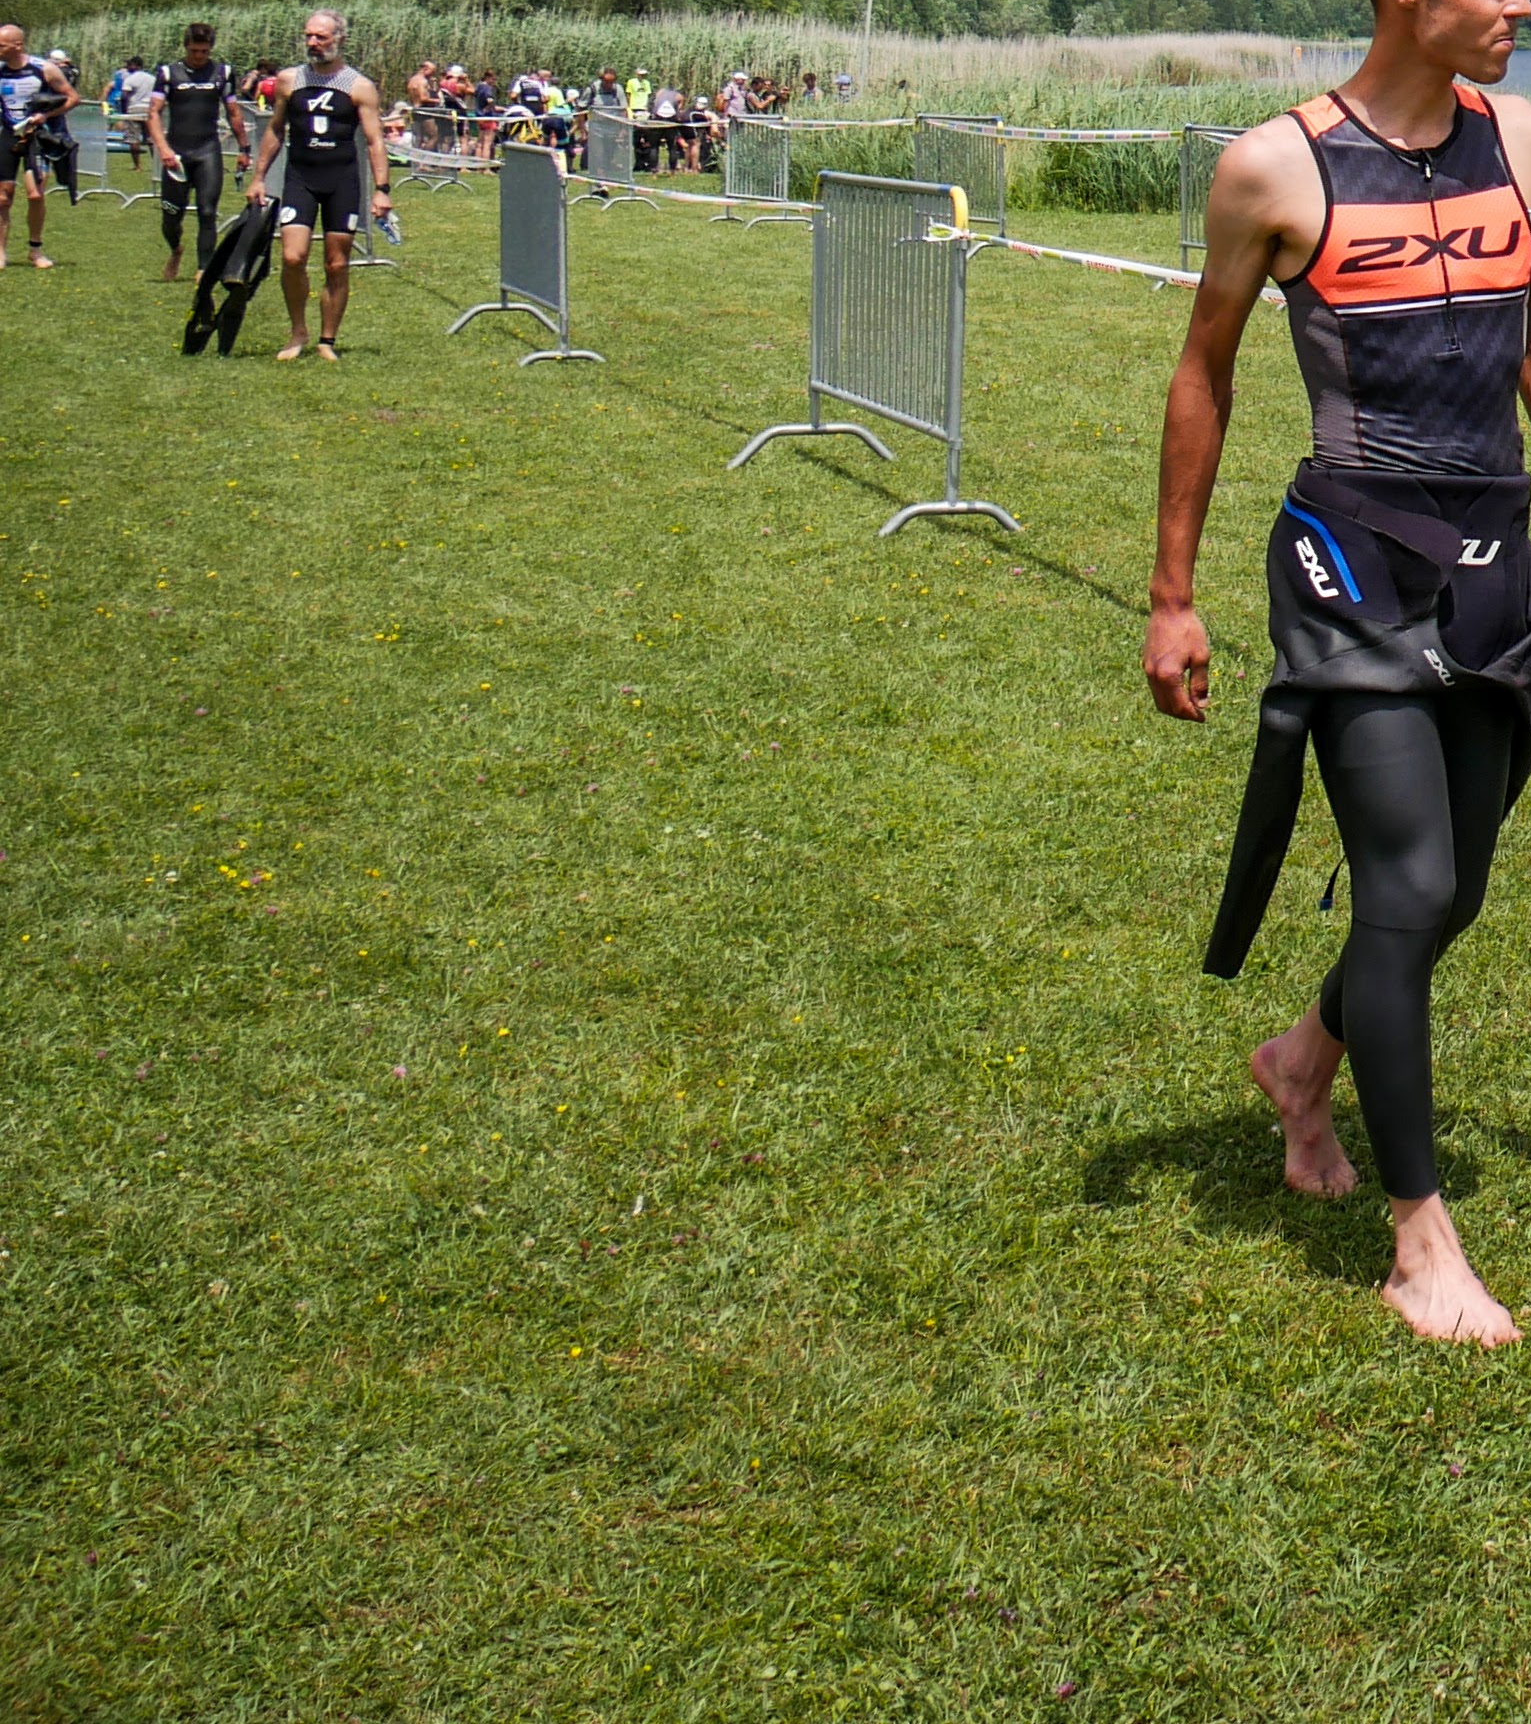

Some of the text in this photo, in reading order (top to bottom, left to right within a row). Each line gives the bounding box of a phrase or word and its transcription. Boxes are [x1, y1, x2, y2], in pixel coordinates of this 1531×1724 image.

[1336, 220, 1522, 275] 2XU
[1294, 536, 1340, 599] 2XU
[1423, 648, 1456, 687] 2XU
